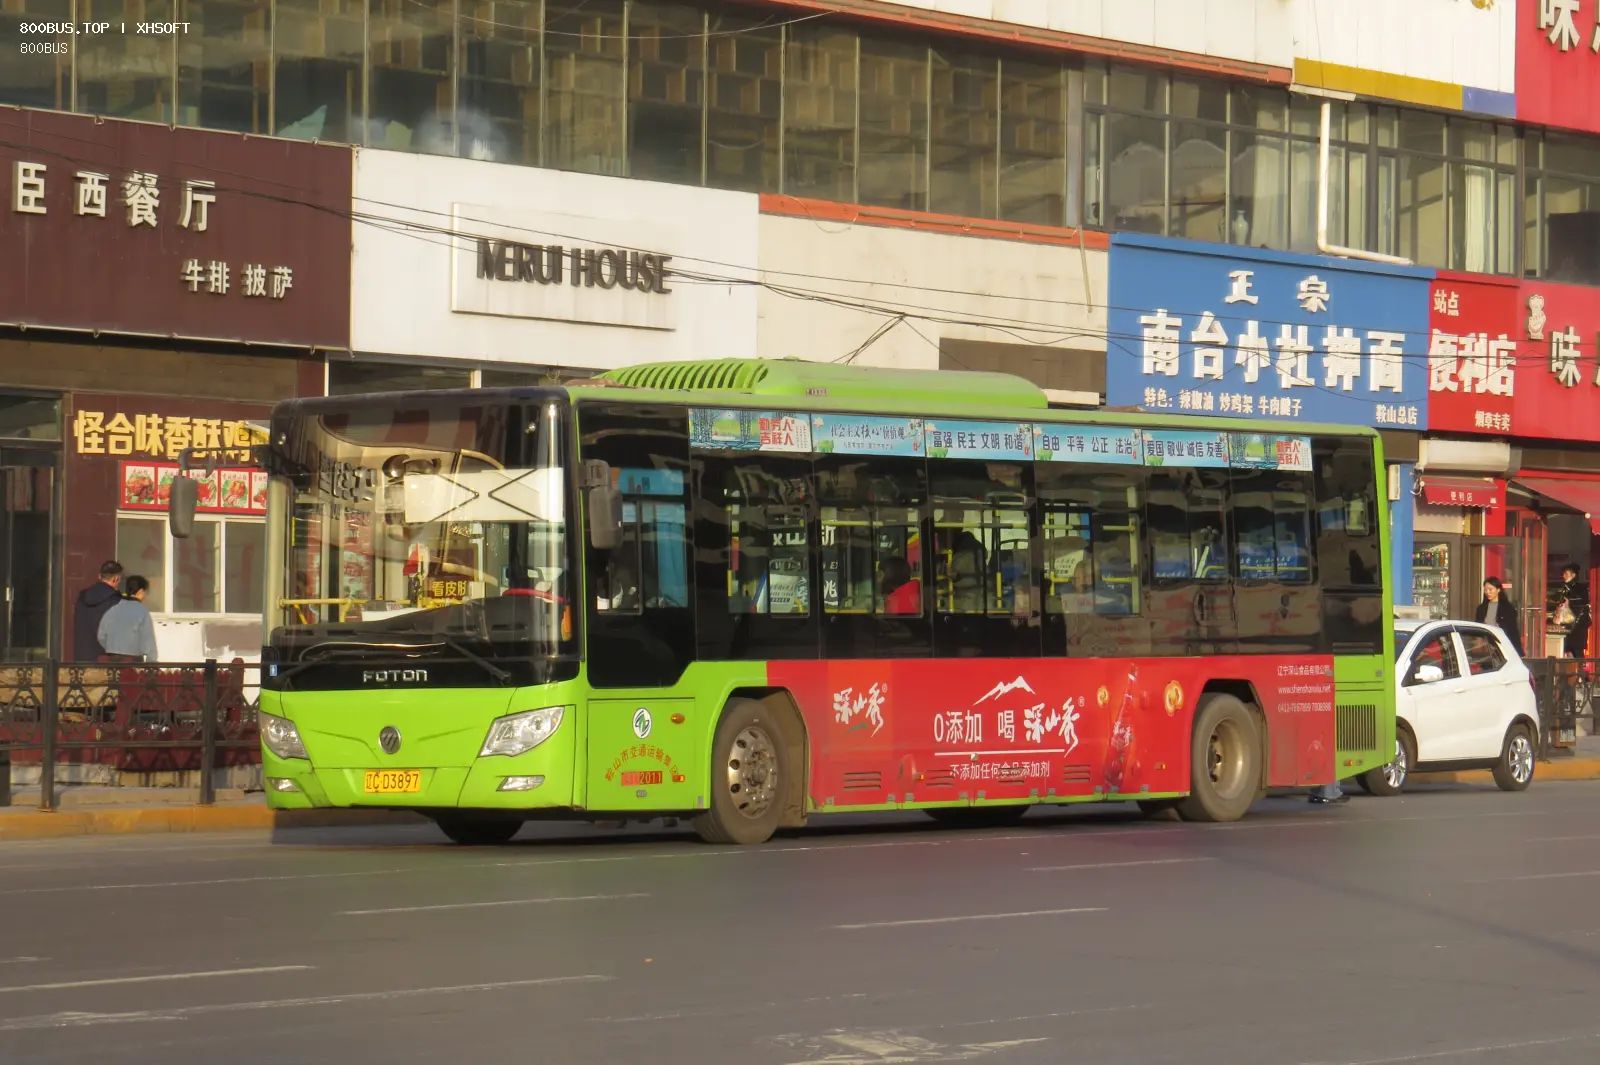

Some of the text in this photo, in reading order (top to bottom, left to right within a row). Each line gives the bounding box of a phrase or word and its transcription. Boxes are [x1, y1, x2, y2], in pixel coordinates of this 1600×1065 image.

[476, 238, 673, 294] MERUI HOUSE
[181, 259, 293, 300] 牛排 披萨
[1225, 270, 1330, 313] 正宗
[1433, 289, 1460, 316] 站点
[1428, 328, 1517, 397] 便利店
[1179, 389, 1214, 411] 辣椒油
[1375, 404, 1418, 426] 鞍山总店
[1474, 410, 1511, 432] 烟草专卖
[759, 432, 795, 446] 吉祥人
[933, 431, 1024, 451] 富强 民主 文明 和谐
[1042, 434, 1133, 455] 自由 平等 公正 法治
[1146, 440, 1223, 458] 爱国 敬业 诚信 友善
[363, 669, 428, 684] FOTON
[933, 709, 982, 744] 0添加
[997, 709, 1015, 743] 喝
[950, 760, 1050, 780] 不添加任何食品添加剂
